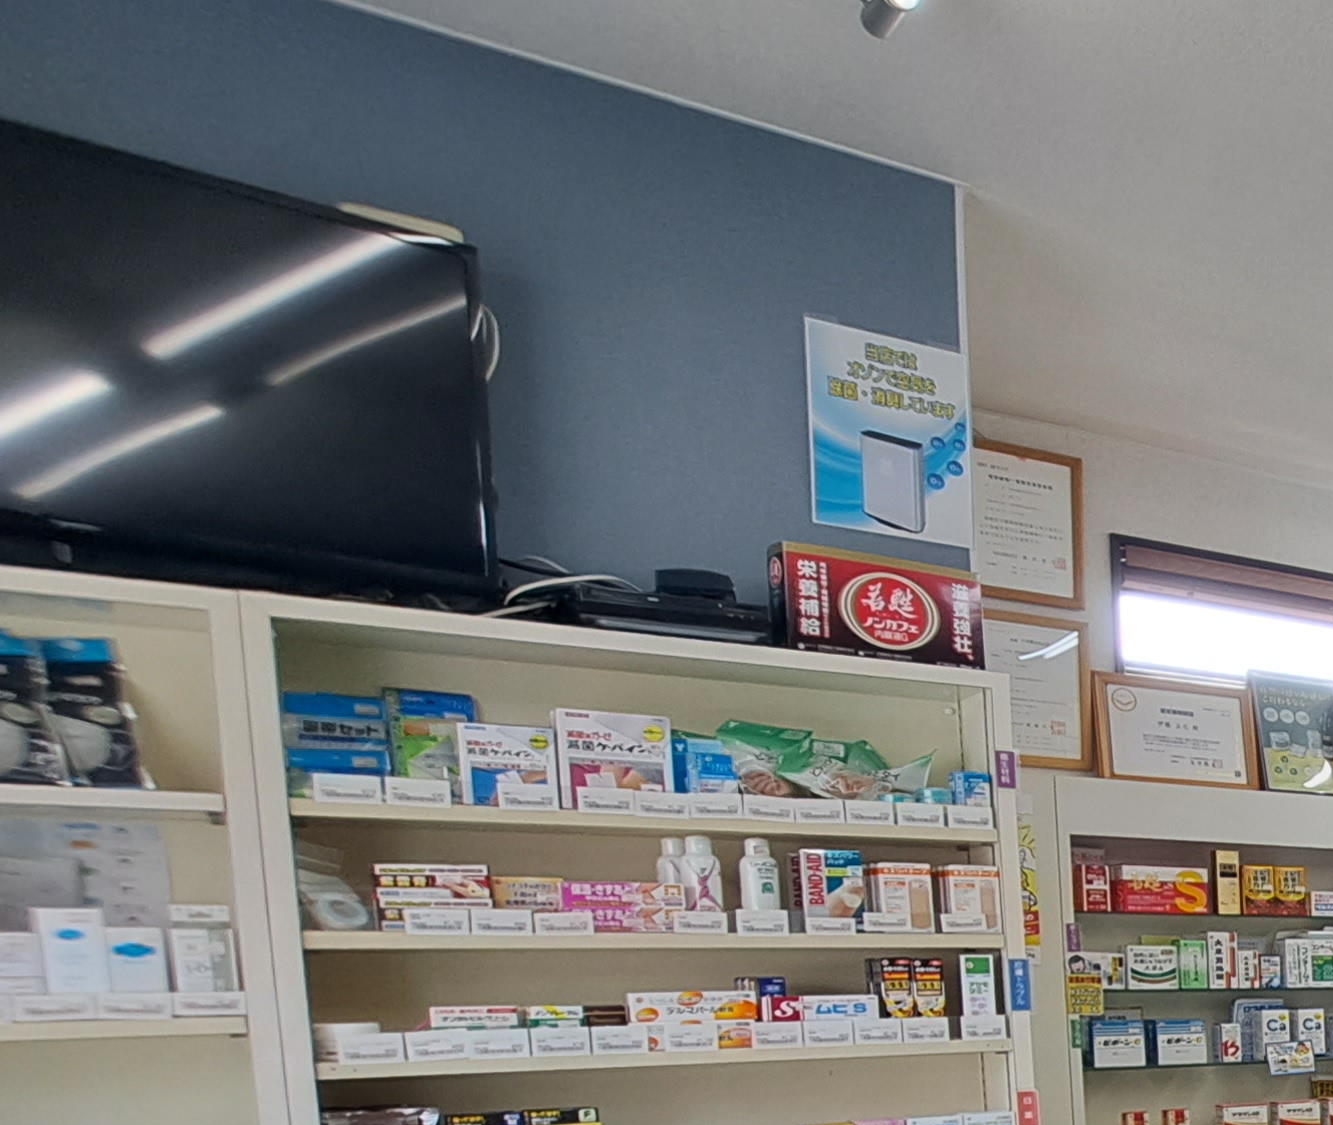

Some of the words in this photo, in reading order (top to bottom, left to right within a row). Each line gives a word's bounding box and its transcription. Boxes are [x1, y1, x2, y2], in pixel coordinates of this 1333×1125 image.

[865, 343, 918, 370] 当店では
[848, 361, 937, 396] オゾンで空気を
[797, 559, 821, 637] 栄養補給
[862, 617, 920, 633] ノンカフェ
[809, 853, 823, 906] BAND-AID
[1266, 1018, 1287, 1032] Ca
[1302, 1017, 1322, 1031] Ca
